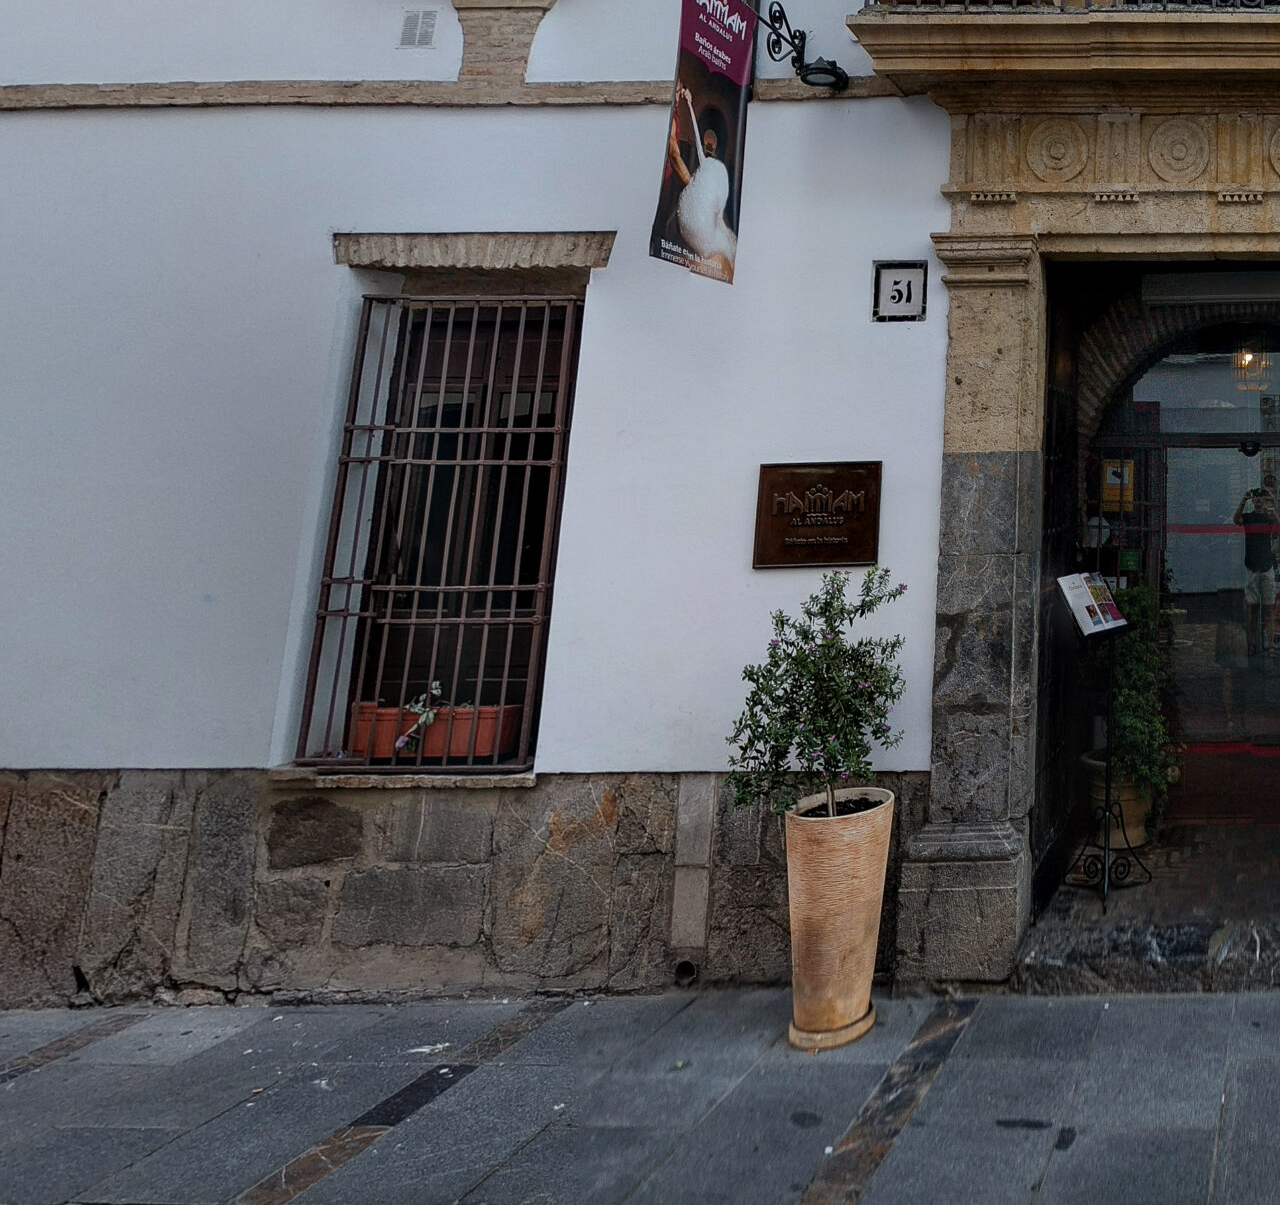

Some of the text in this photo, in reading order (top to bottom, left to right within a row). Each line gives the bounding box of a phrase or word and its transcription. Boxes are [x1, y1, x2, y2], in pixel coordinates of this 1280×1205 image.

[699, 13, 733, 42] AL ANDALUS
[695, 32, 731, 64] Baños árabes
[698, 46, 711, 60] Arab
[890, 279, 913, 304] 51
[772, 490, 865, 515] HAMMAM
